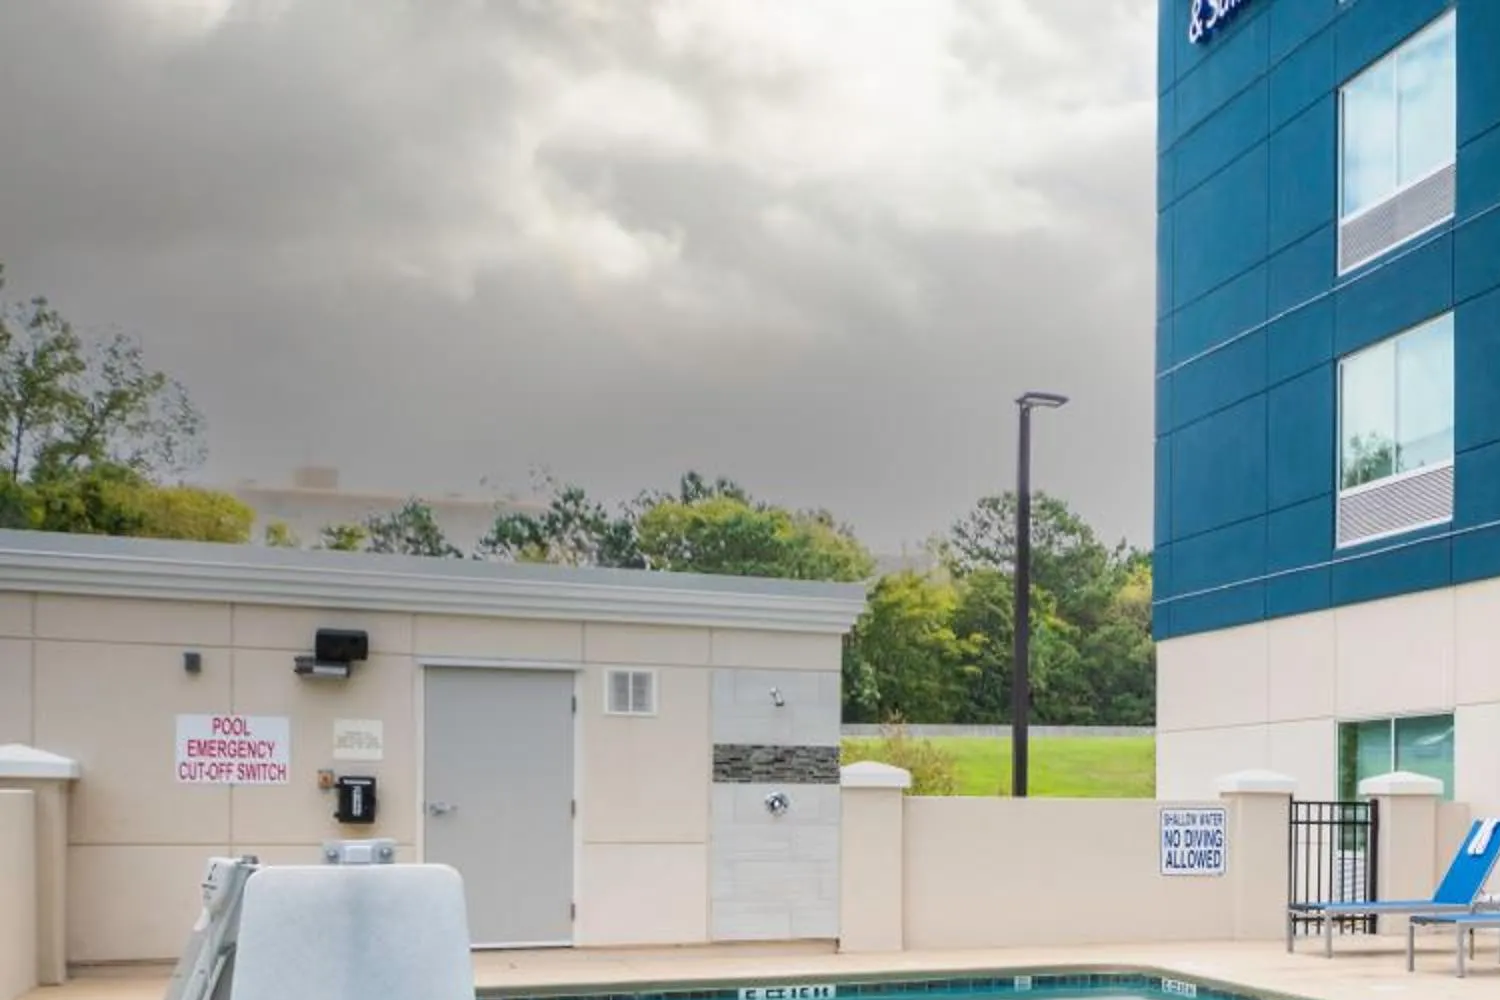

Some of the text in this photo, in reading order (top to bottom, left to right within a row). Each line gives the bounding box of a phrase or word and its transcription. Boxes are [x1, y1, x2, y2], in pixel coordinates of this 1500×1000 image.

[212, 717, 250, 736] POOL
[187, 740, 275, 758] EMERGENCY
[178, 762, 286, 780] CUT-OFF SWITCH
[1164, 829, 1222, 847] NO DIVING
[1165, 850, 1221, 868] ALLOWED
